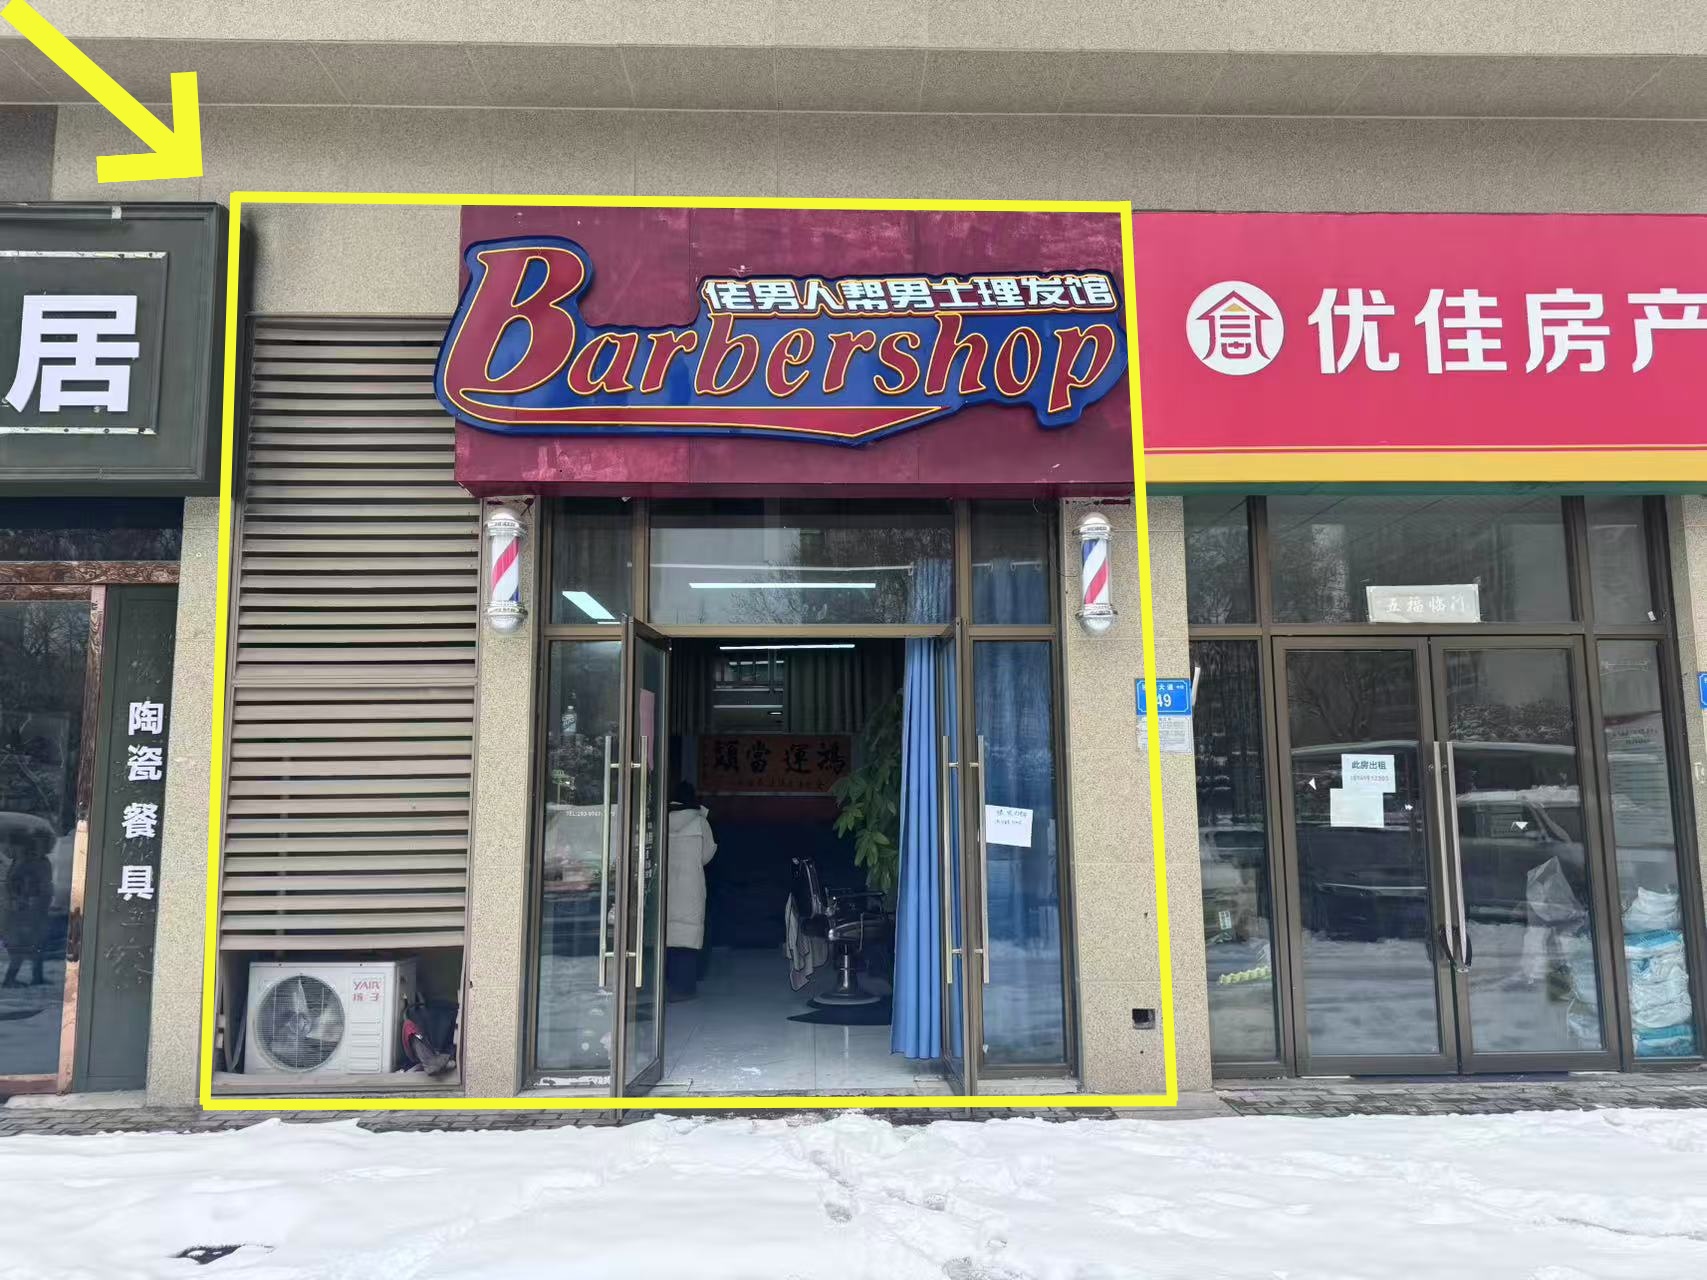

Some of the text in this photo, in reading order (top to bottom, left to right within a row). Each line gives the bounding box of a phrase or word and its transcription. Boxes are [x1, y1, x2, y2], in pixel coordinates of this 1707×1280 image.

[444, 245, 1117, 425] Barbershop
[704, 276, 1115, 310] 佬男人帮男士理发馆
[1307, 287, 1707, 375] 优佳房产
[5, 294, 140, 413] 居
[117, 700, 165, 901] 陶瓷餐具
[1351, 760, 1387, 771] 此房出租
[353, 980, 381, 991] YAIR
